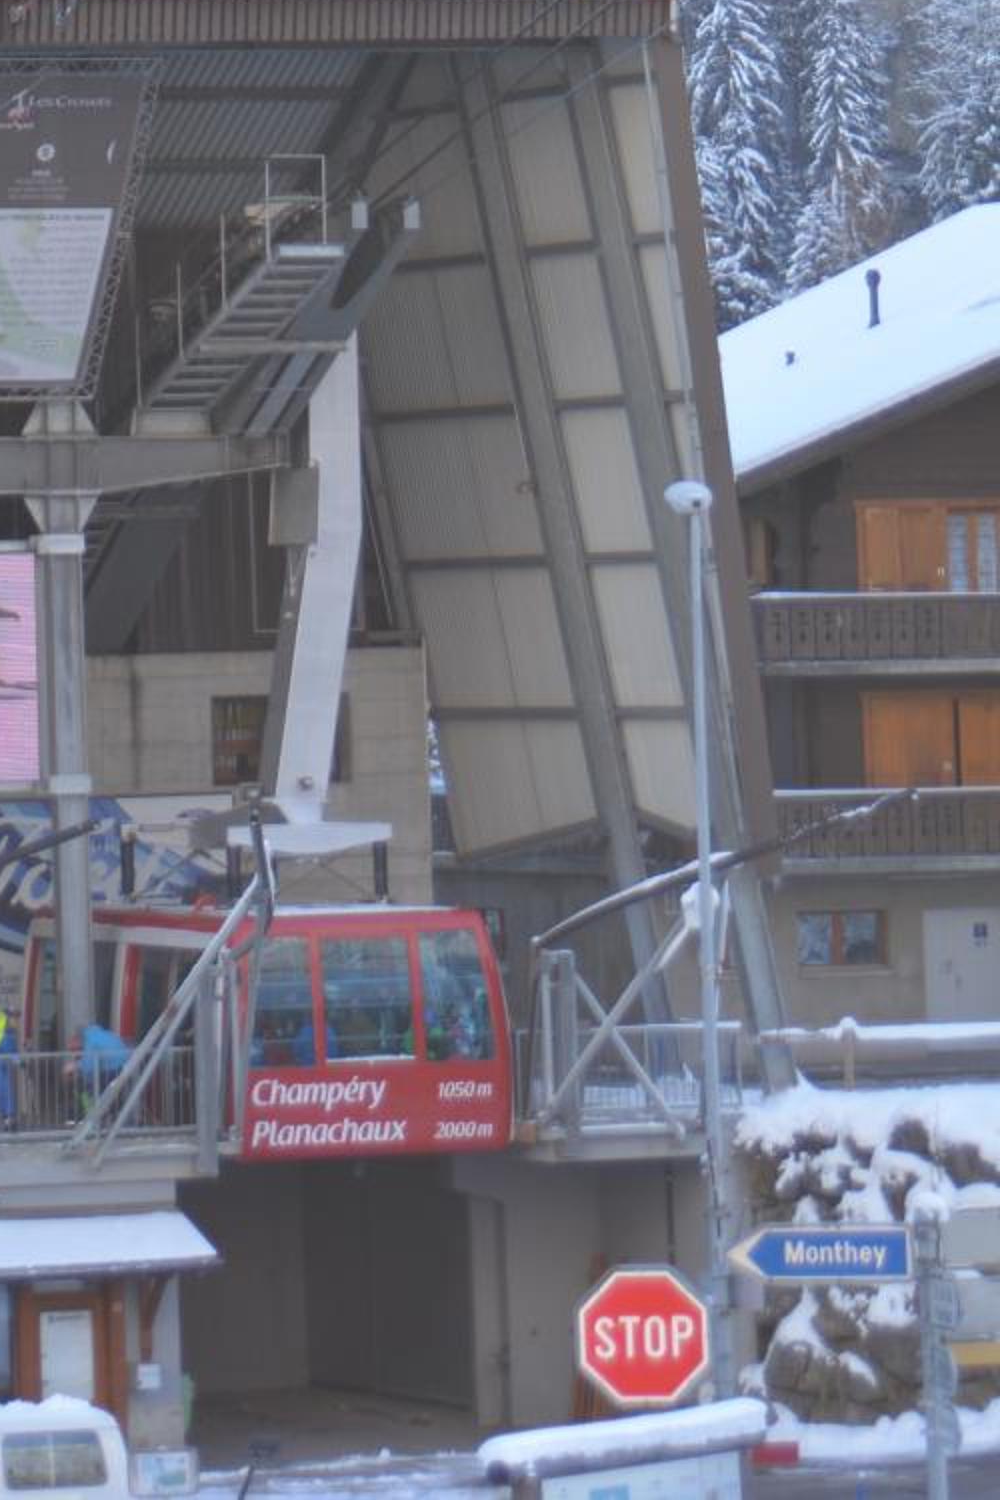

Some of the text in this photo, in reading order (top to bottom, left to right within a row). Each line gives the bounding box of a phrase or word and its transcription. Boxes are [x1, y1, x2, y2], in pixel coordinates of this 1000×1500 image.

[252, 1075, 493, 1112] Champéry 1050 m
[252, 1118, 493, 1148] Planachaux 2000 m
[783, 1241, 888, 1268] Monthey
[594, 1315, 695, 1360] STOP
